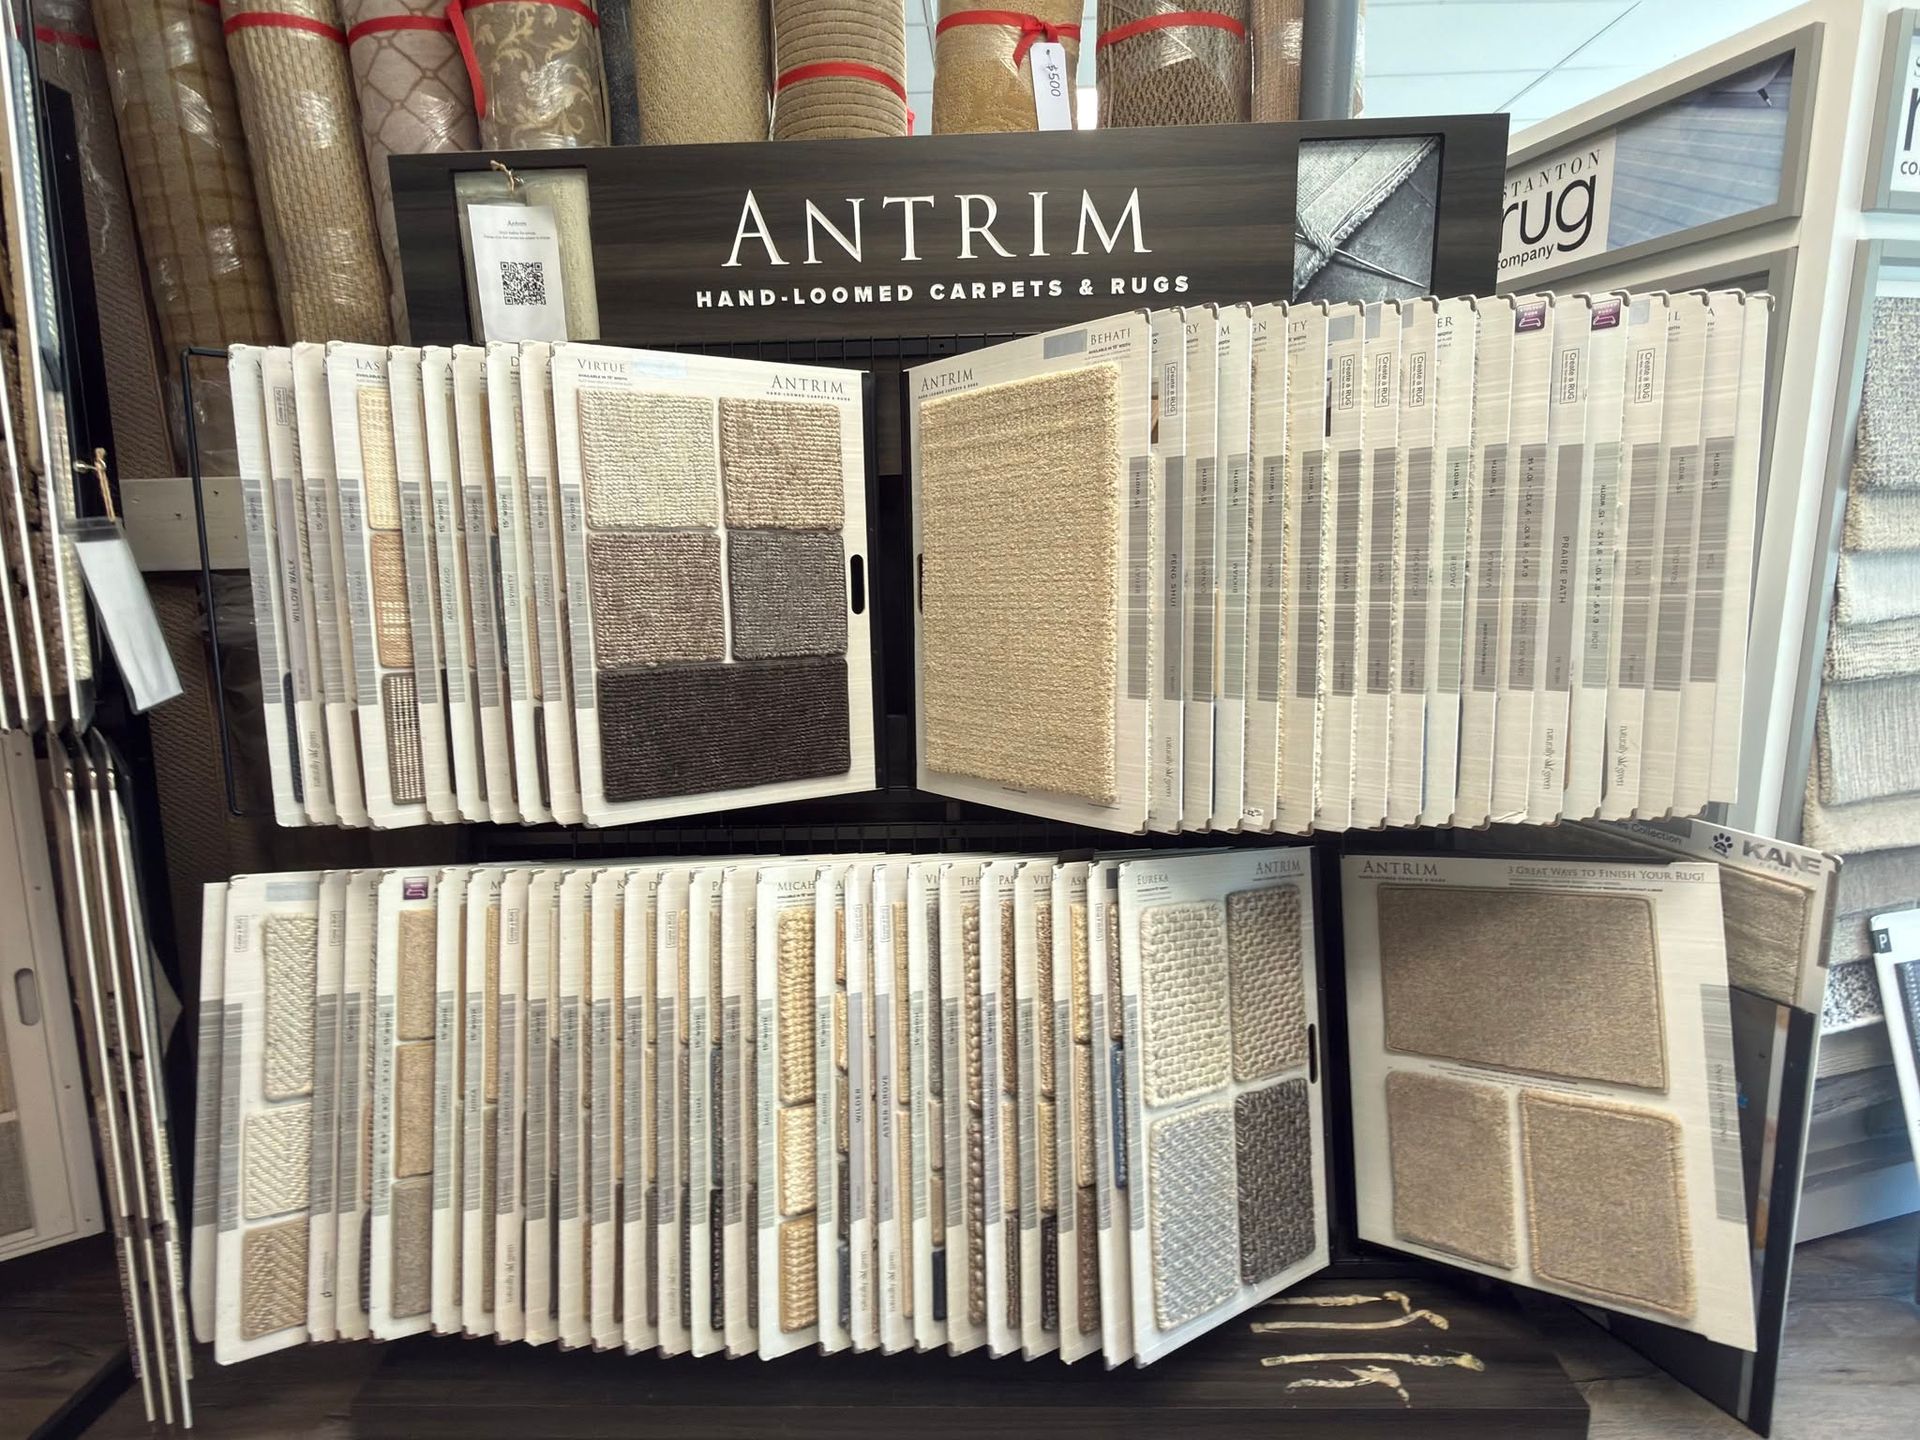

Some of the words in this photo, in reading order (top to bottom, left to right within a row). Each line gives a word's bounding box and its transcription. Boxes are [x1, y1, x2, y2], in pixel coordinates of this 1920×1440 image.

[1046, 64, 1061, 97] $500
[1503, 148, 1600, 201] STANTON
[1499, 174, 1597, 253] rug
[721, 187, 1152, 267] ANTRIM
[696, 285, 914, 309] HAND-LOOMED
[930, 280, 1063, 301] CARPETS
[1079, 279, 1094, 296] &
[1110, 275, 1190, 294] RUGS
[1090, 327, 1130, 346] BEHATI
[577, 358, 625, 373] VIRTUE
[771, 374, 844, 394] ANTRIM
[921, 368, 973, 392] ANTRIM
[1560, 536, 1569, 574] PRAIRIE
[287, 559, 296, 586] WALK
[1559, 579, 1567, 604] PATH
[291, 588, 300, 624] WILLOW
[1632, 823, 1682, 846] Collection
[1255, 859, 1301, 875] ANTRIM
[1363, 860, 1438, 876] ANTRIM
[1742, 840, 1822, 876] KANE
[1136, 873, 1169, 885] EUREKA
[1507, 867, 1513, 875] 3
[1515, 866, 1549, 876] GREAT
[1550, 867, 1577, 877] WAYS
[1581, 869, 1596, 877] TO
[1599, 870, 1636, 879] FINISH
[1639, 871, 1672, 880] YOUR
[1675, 871, 1705, 881] RUG!
[777, 881, 816, 891] MICAH
